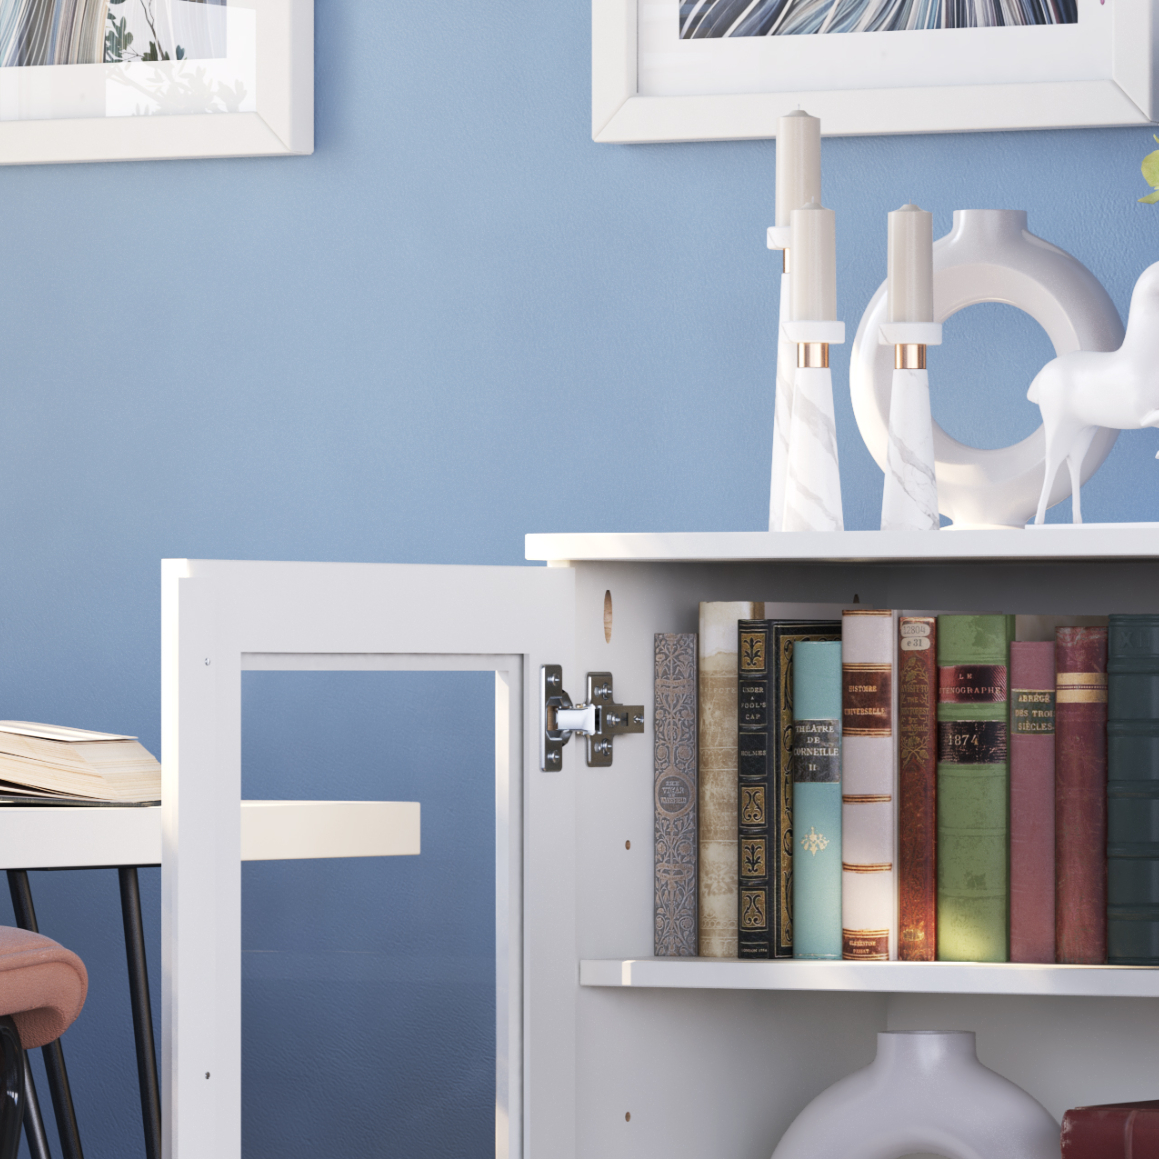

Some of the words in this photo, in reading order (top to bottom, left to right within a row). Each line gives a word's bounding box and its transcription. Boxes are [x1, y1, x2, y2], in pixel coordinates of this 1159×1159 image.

[1031, 709, 1055, 718] TROI
[807, 736, 820, 744] DE
[949, 734, 979, 746] 1874
